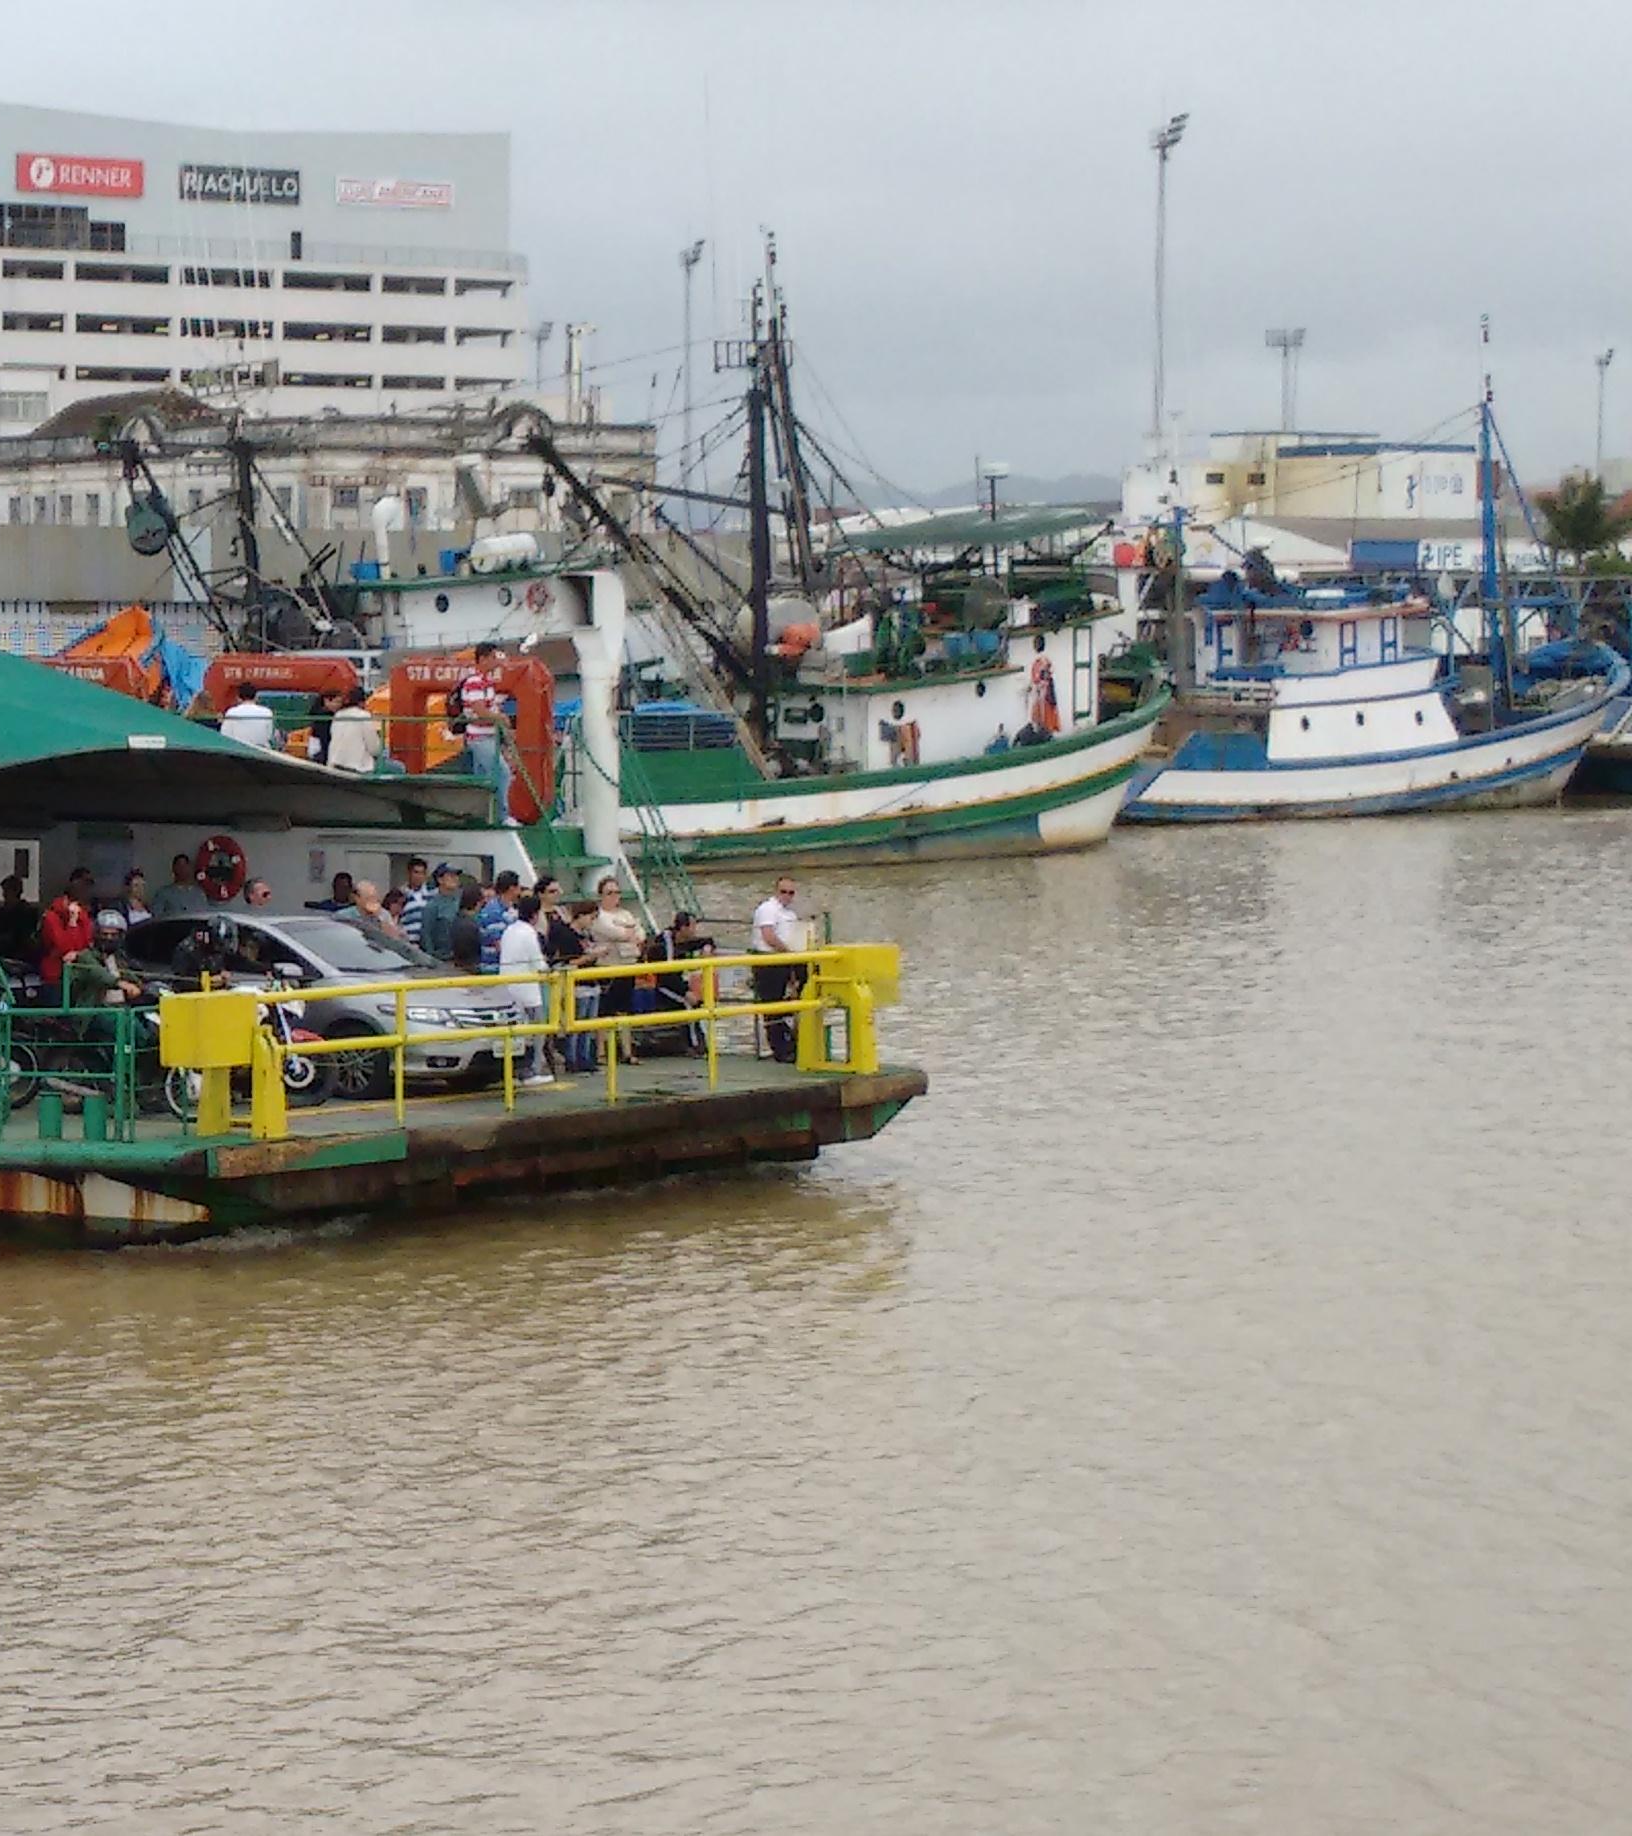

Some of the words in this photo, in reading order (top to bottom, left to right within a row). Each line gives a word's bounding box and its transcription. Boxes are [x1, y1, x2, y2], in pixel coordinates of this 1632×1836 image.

[59, 164, 131, 187] RENNER
[184, 171, 298, 197] RIACHUELO
[406, 665, 431, 681] STA
